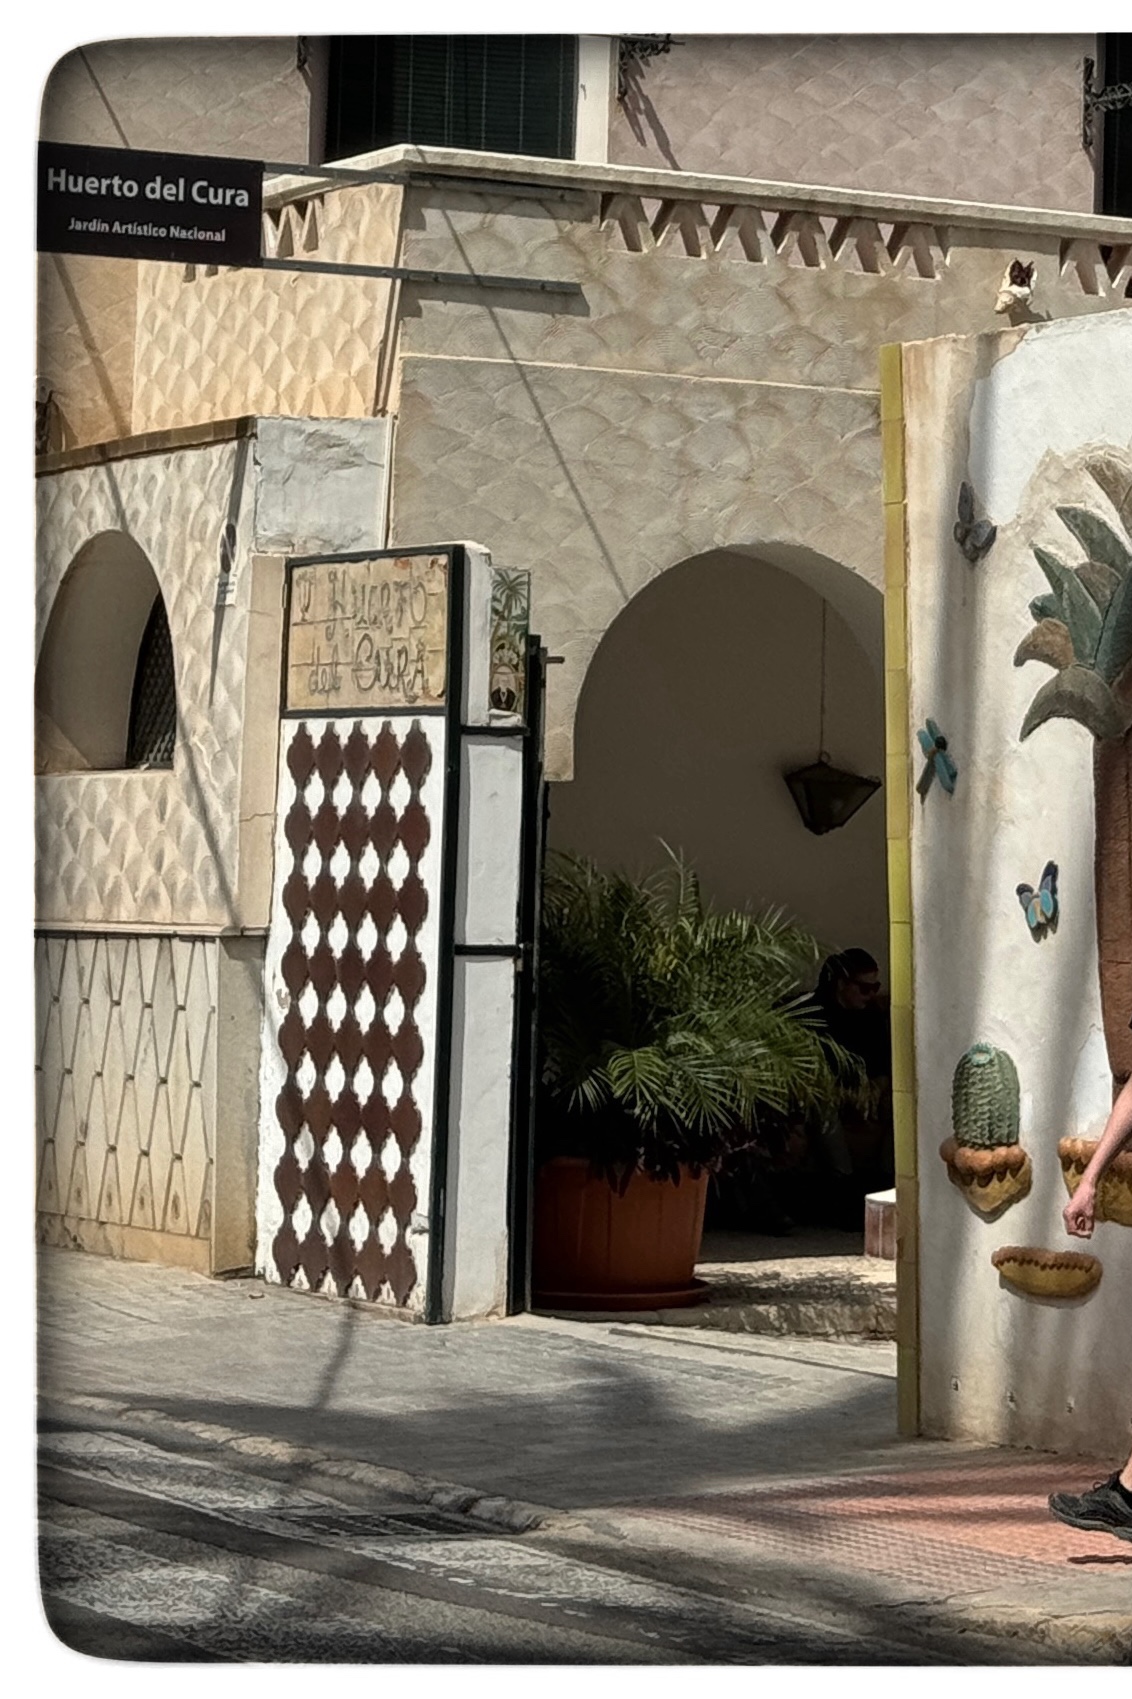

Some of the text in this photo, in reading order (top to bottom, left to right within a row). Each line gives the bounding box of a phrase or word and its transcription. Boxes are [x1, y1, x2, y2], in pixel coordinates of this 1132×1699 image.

[47, 167, 249, 208] Huerto del Cura
[112, 220, 167, 239] Artístico
[169, 226, 226, 243] Nacional
